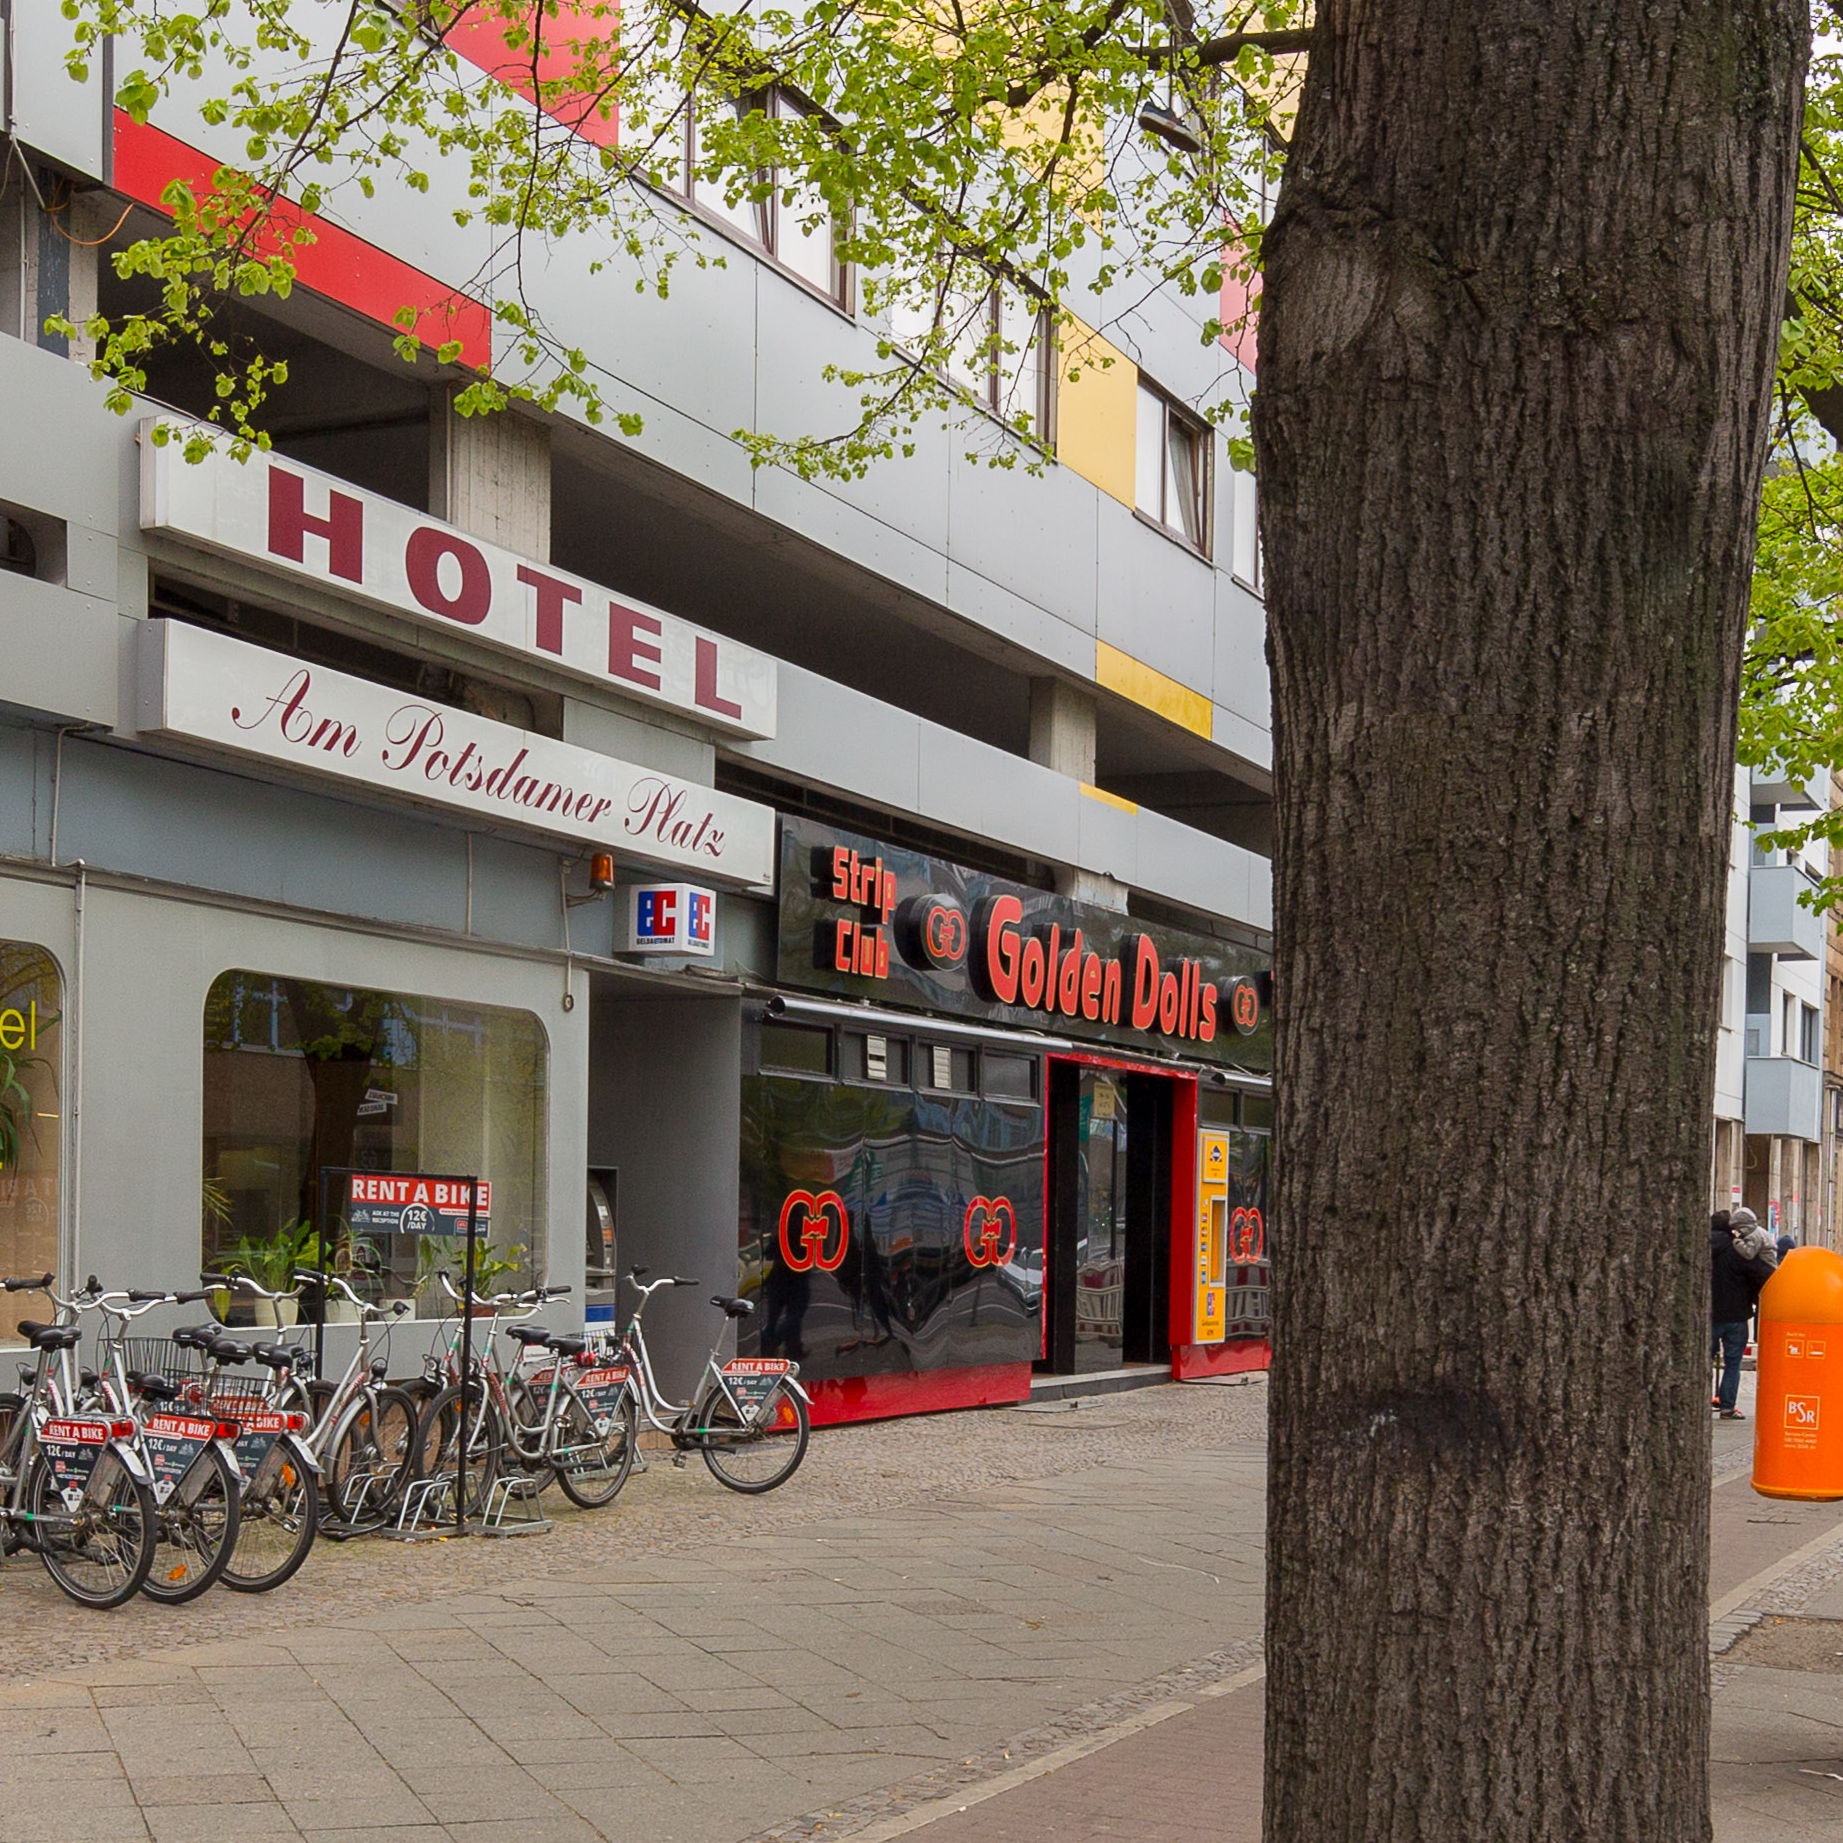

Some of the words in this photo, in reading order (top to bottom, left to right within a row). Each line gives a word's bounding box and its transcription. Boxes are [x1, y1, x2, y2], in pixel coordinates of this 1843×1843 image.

[267, 464, 742, 720] HOTEL
[231, 669, 363, 759] Am
[381, 703, 612, 824] Potsdamer
[623, 776, 726, 859] Platz
[832, 845, 896, 925] Strip
[834, 917, 890, 980] Club
[987, 894, 1122, 1025] Golden
[1131, 933, 1218, 1043] Dolls
[351, 1178, 410, 1202] RENT
[413, 1182, 430, 1204] A
[434, 1183, 488, 1206] BIKE
[407, 1209, 428, 1222] 12€
[407, 1221, 427, 1230] /DAY
[585, 1371, 605, 1384] RENT
[731, 1361, 757, 1371] RENT
[757, 1362, 764, 1371] A
[765, 1362, 785, 1372] BIKE
[1788, 1401, 1815, 1423] BSR
[48, 1423, 71, 1438] RENT
[72, 1426, 85, 1439] A
[86, 1426, 104, 1441] BIKE
[152, 1417, 177, 1432] RENT
[178, 1420, 188, 1433] A
[189, 1420, 211, 1436] BIKE
